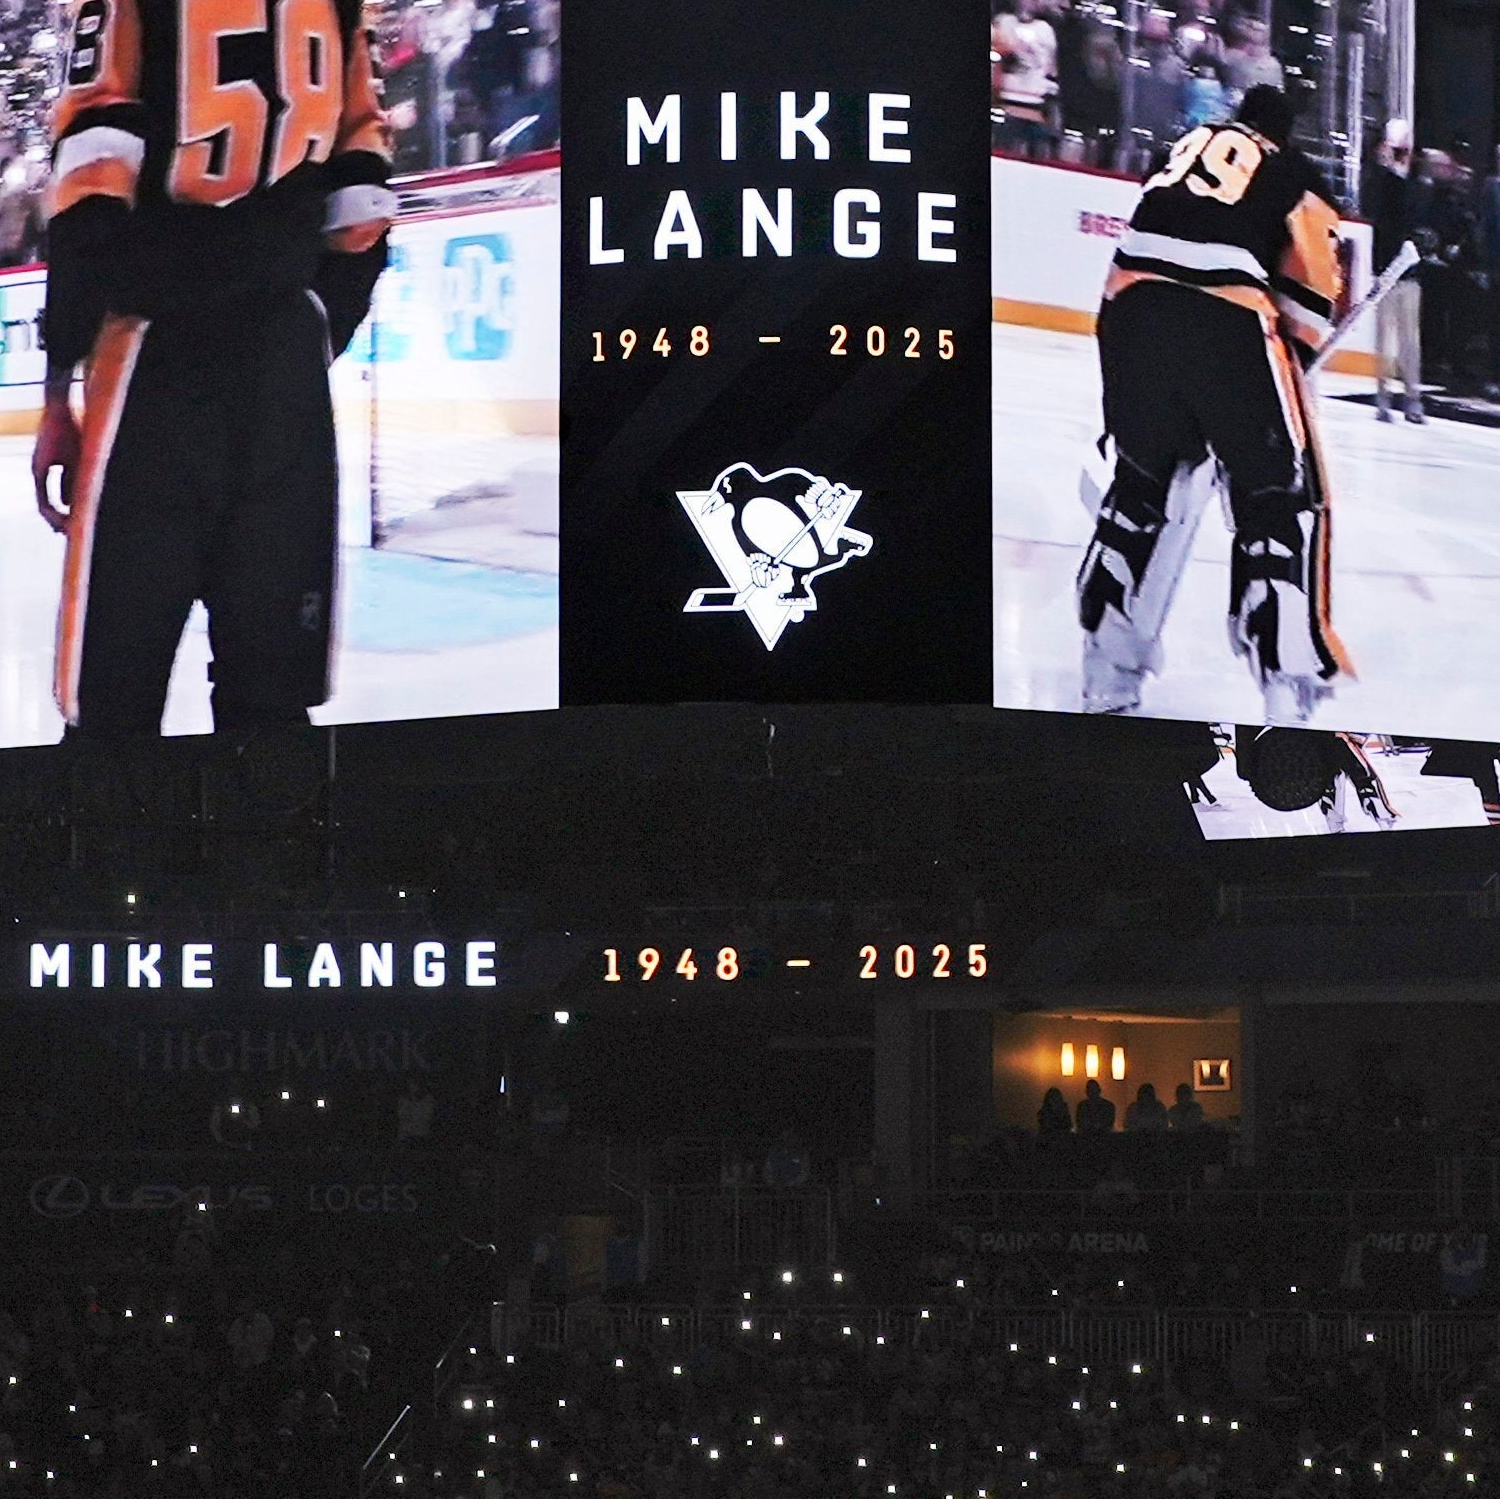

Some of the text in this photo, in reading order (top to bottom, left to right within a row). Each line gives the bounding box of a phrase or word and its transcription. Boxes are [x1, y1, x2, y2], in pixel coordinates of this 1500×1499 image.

[626, 91, 913, 166] MIKE
[589, 187, 958, 265] LANGE
[592, 325, 711, 363] 1948
[829, 324, 955, 361] 2025
[29, 941, 498, 989] MIKE LANGE
[603, 946, 741, 983] 1948
[859, 943, 989, 980] 2025
[135, 1029, 433, 1072] HIGHMARK
[308, 1183, 419, 1213] LOGES
[1067, 1232, 1150, 1254] ARENA
